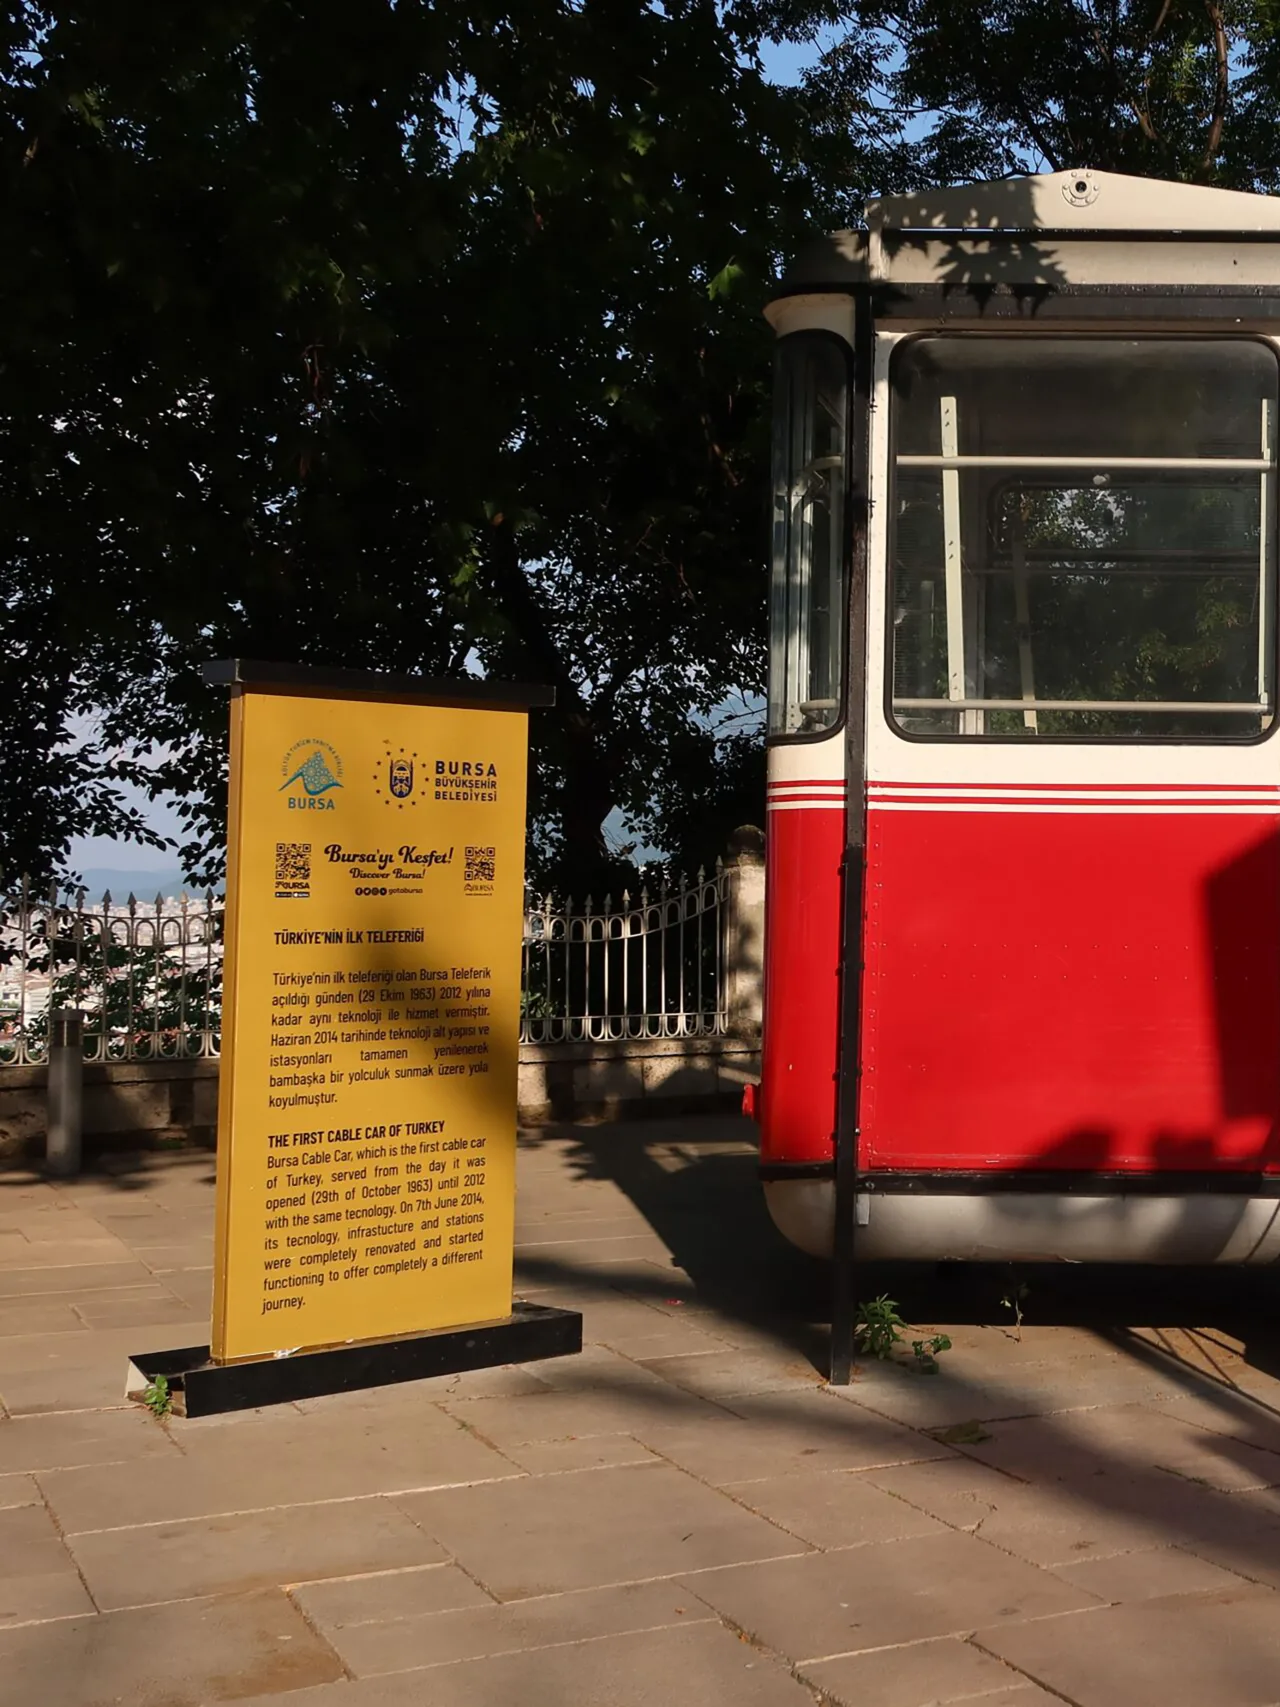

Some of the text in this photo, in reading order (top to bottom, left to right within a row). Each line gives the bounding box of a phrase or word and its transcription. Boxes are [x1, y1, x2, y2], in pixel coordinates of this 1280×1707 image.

[435, 761, 497, 777] BURSA
[288, 797, 335, 810] BURSA
[435, 790, 497, 802] BELEDİYESİ
[324, 844, 394, 870] Bursa'yı
[349, 868, 426, 879] Discover Bursa!
[274, 928, 424, 945] TÜRKİYE'NİN İLK TELEFERİĞİ
[273, 967, 491, 987] Türkiye'nin ilk teleferiği olan Bursa Teleferik
[272, 986, 490, 1008] açıldığı günden (29 Ekim 1963) 2012 yılına
[271, 1005, 490, 1027] kadar aynı teknoloji ile hizmet vermiştir.
[271, 1026, 490, 1046] Haziran 2014 tarihinde teknoloji alt yapısı ve
[270, 1042, 488, 1068] istasyonları tamamen yenilenerek
[270, 1061, 488, 1088] bambaşka bir yolculuk sunmak üzere yola
[269, 1092, 338, 1110] koyulmuştur.
[268, 1120, 445, 1148] THE FIRST CABLE CAR OF TURKEY
[267, 1138, 486, 1169] Bursa Cable Car, which is the first cable car
[267, 1157, 485, 1189] of Turkey, served from the day it was
[266, 1173, 485, 1212] opened (29th of October 1963) until 2012
[265, 1193, 484, 1230] with the same tecnology. On 7th June 2014,
[265, 1213, 484, 1250] its tecnology, infrastucture and stations
[264, 1230, 483, 1270] were completely renovated and started
[264, 1249, 483, 1291] functioning to offer completely a different
[261, 1296, 306, 1315] journey.
